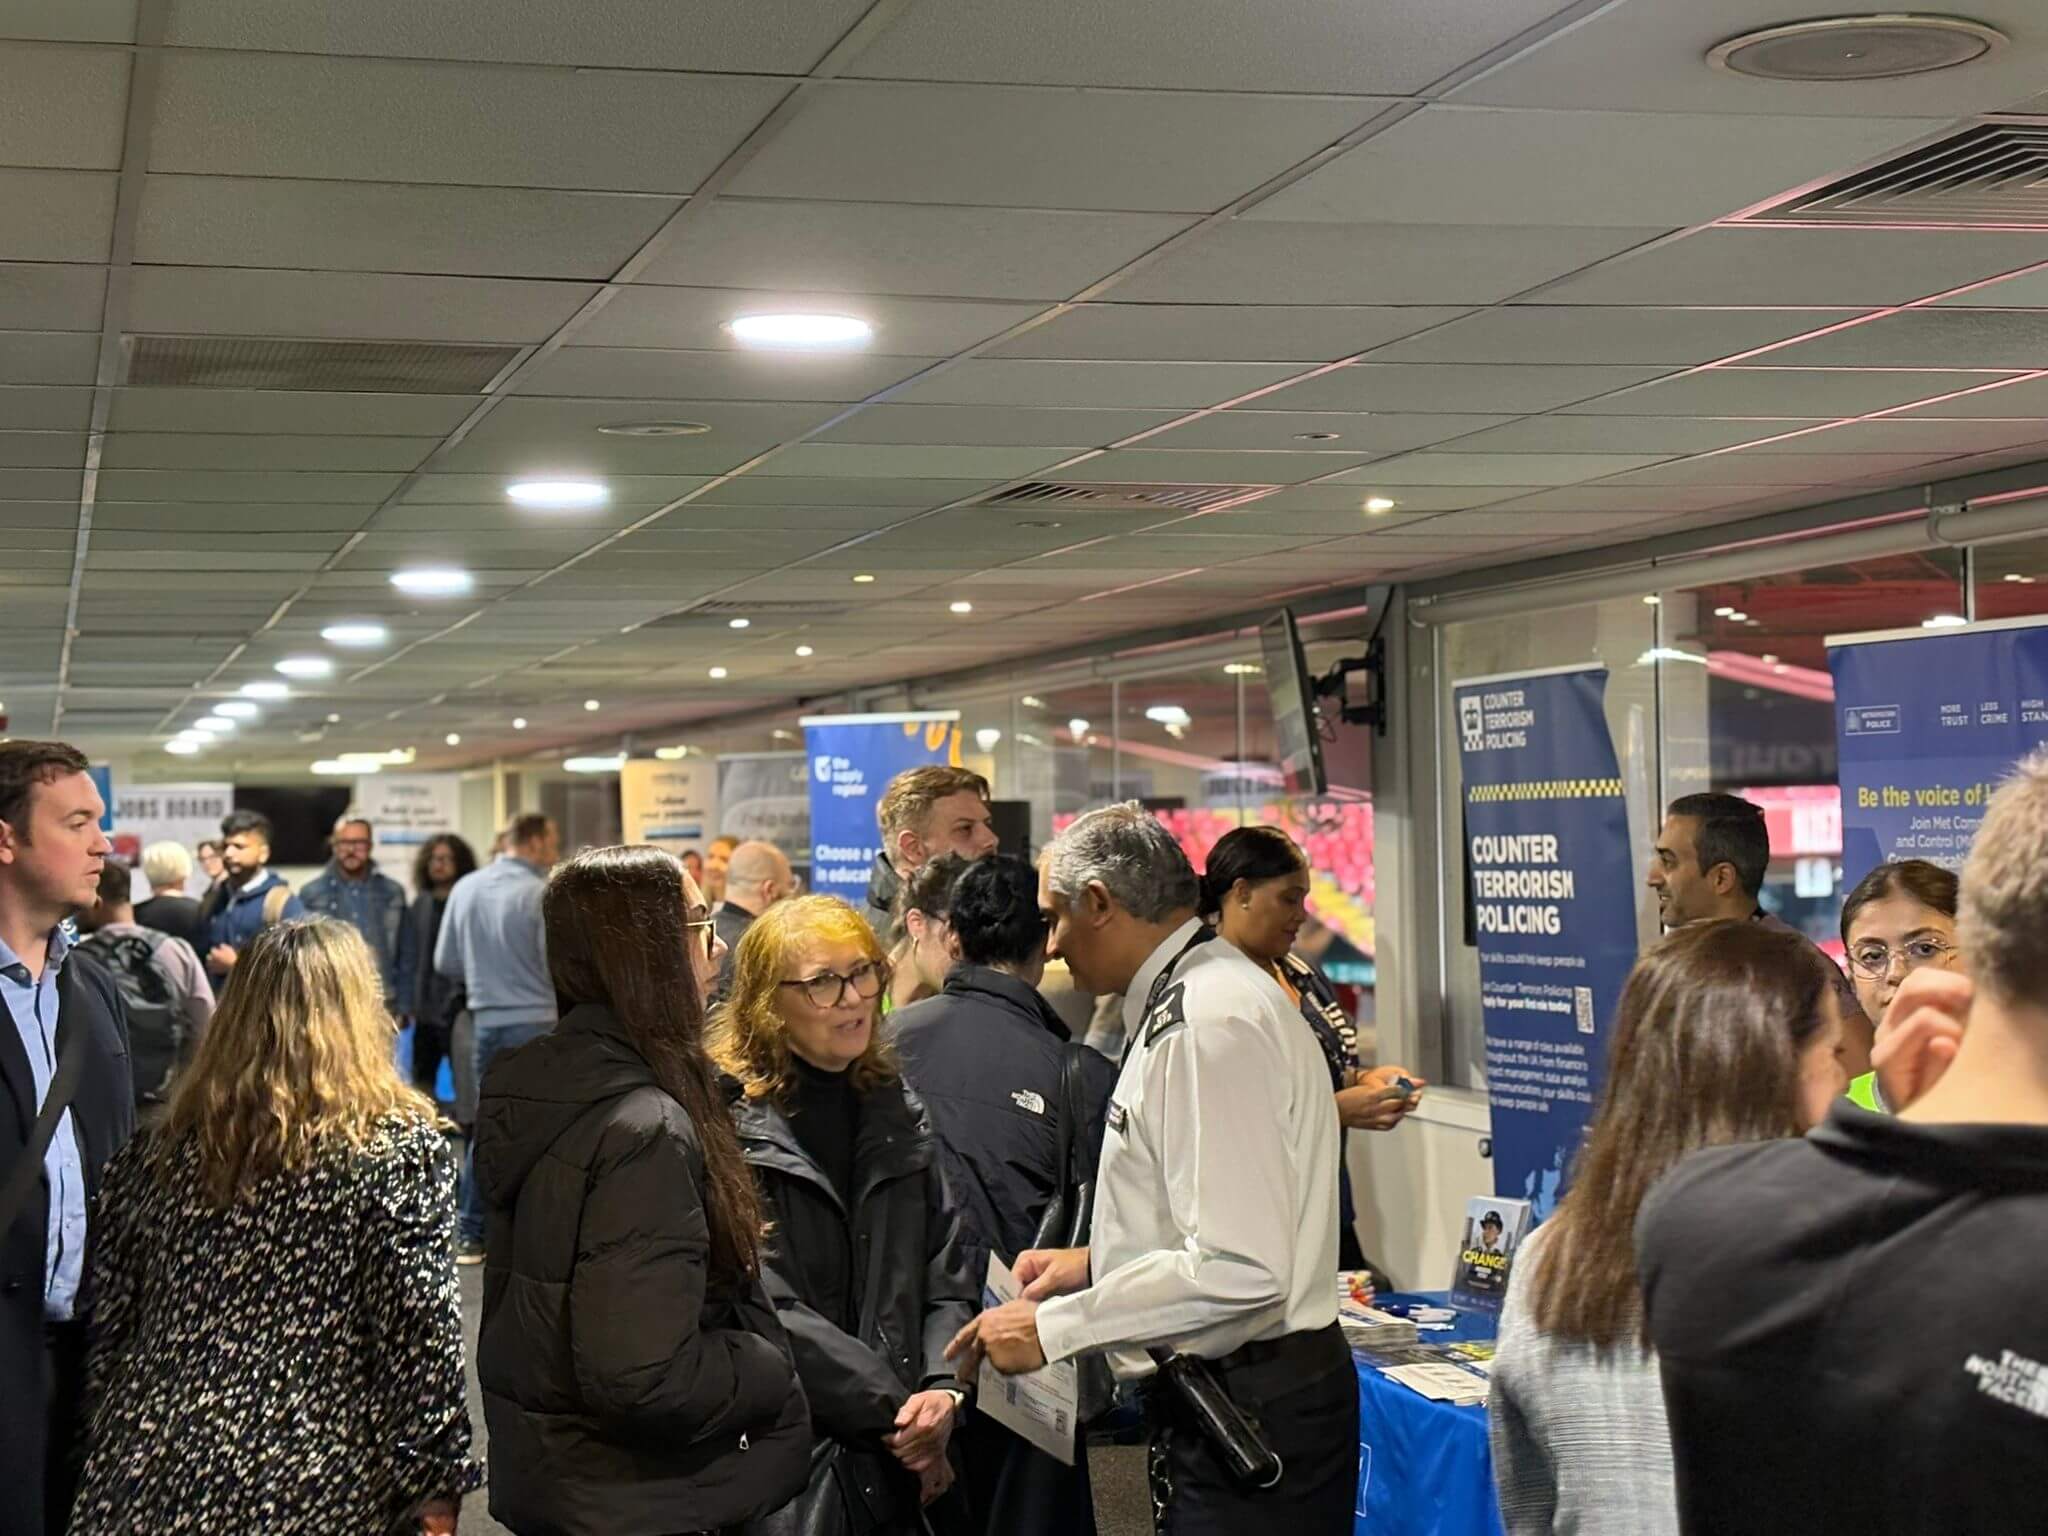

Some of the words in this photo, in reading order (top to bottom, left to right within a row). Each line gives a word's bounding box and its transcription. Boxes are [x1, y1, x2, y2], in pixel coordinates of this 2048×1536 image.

[1484, 690, 1524, 710] COUNTER
[1940, 704, 1962, 714] MORE
[1980, 702, 1999, 712] LESS
[1485, 710, 1534, 729] TERRORISM
[1865, 720, 1892, 729] POLICE
[1940, 715, 1969, 727] TRUST
[1980, 713, 2009, 724] CRIME
[1486, 731, 1526, 749] POLICING
[1858, 786, 1879, 808] Be
[1882, 785, 1910, 807] the
[1915, 784, 1960, 806] voice
[1964, 783, 1983, 805] of
[113, 797, 160, 818] JOBS
[166, 797, 223, 818] BOARD
[1909, 817, 1932, 831] Join
[1932, 816, 1952, 830] Met
[1472, 834, 1558, 864] COUNTER
[1895, 836, 1916, 848] and
[1917, 834, 1955, 848] Control
[815, 844, 861, 862] Choose
[863, 847, 872, 862] a
[828, 866, 873, 884] educat
[1474, 869, 1574, 899] TERRORISM
[1476, 904, 1561, 935] POLICING
[1462, 1249, 1508, 1270] CHANGE
